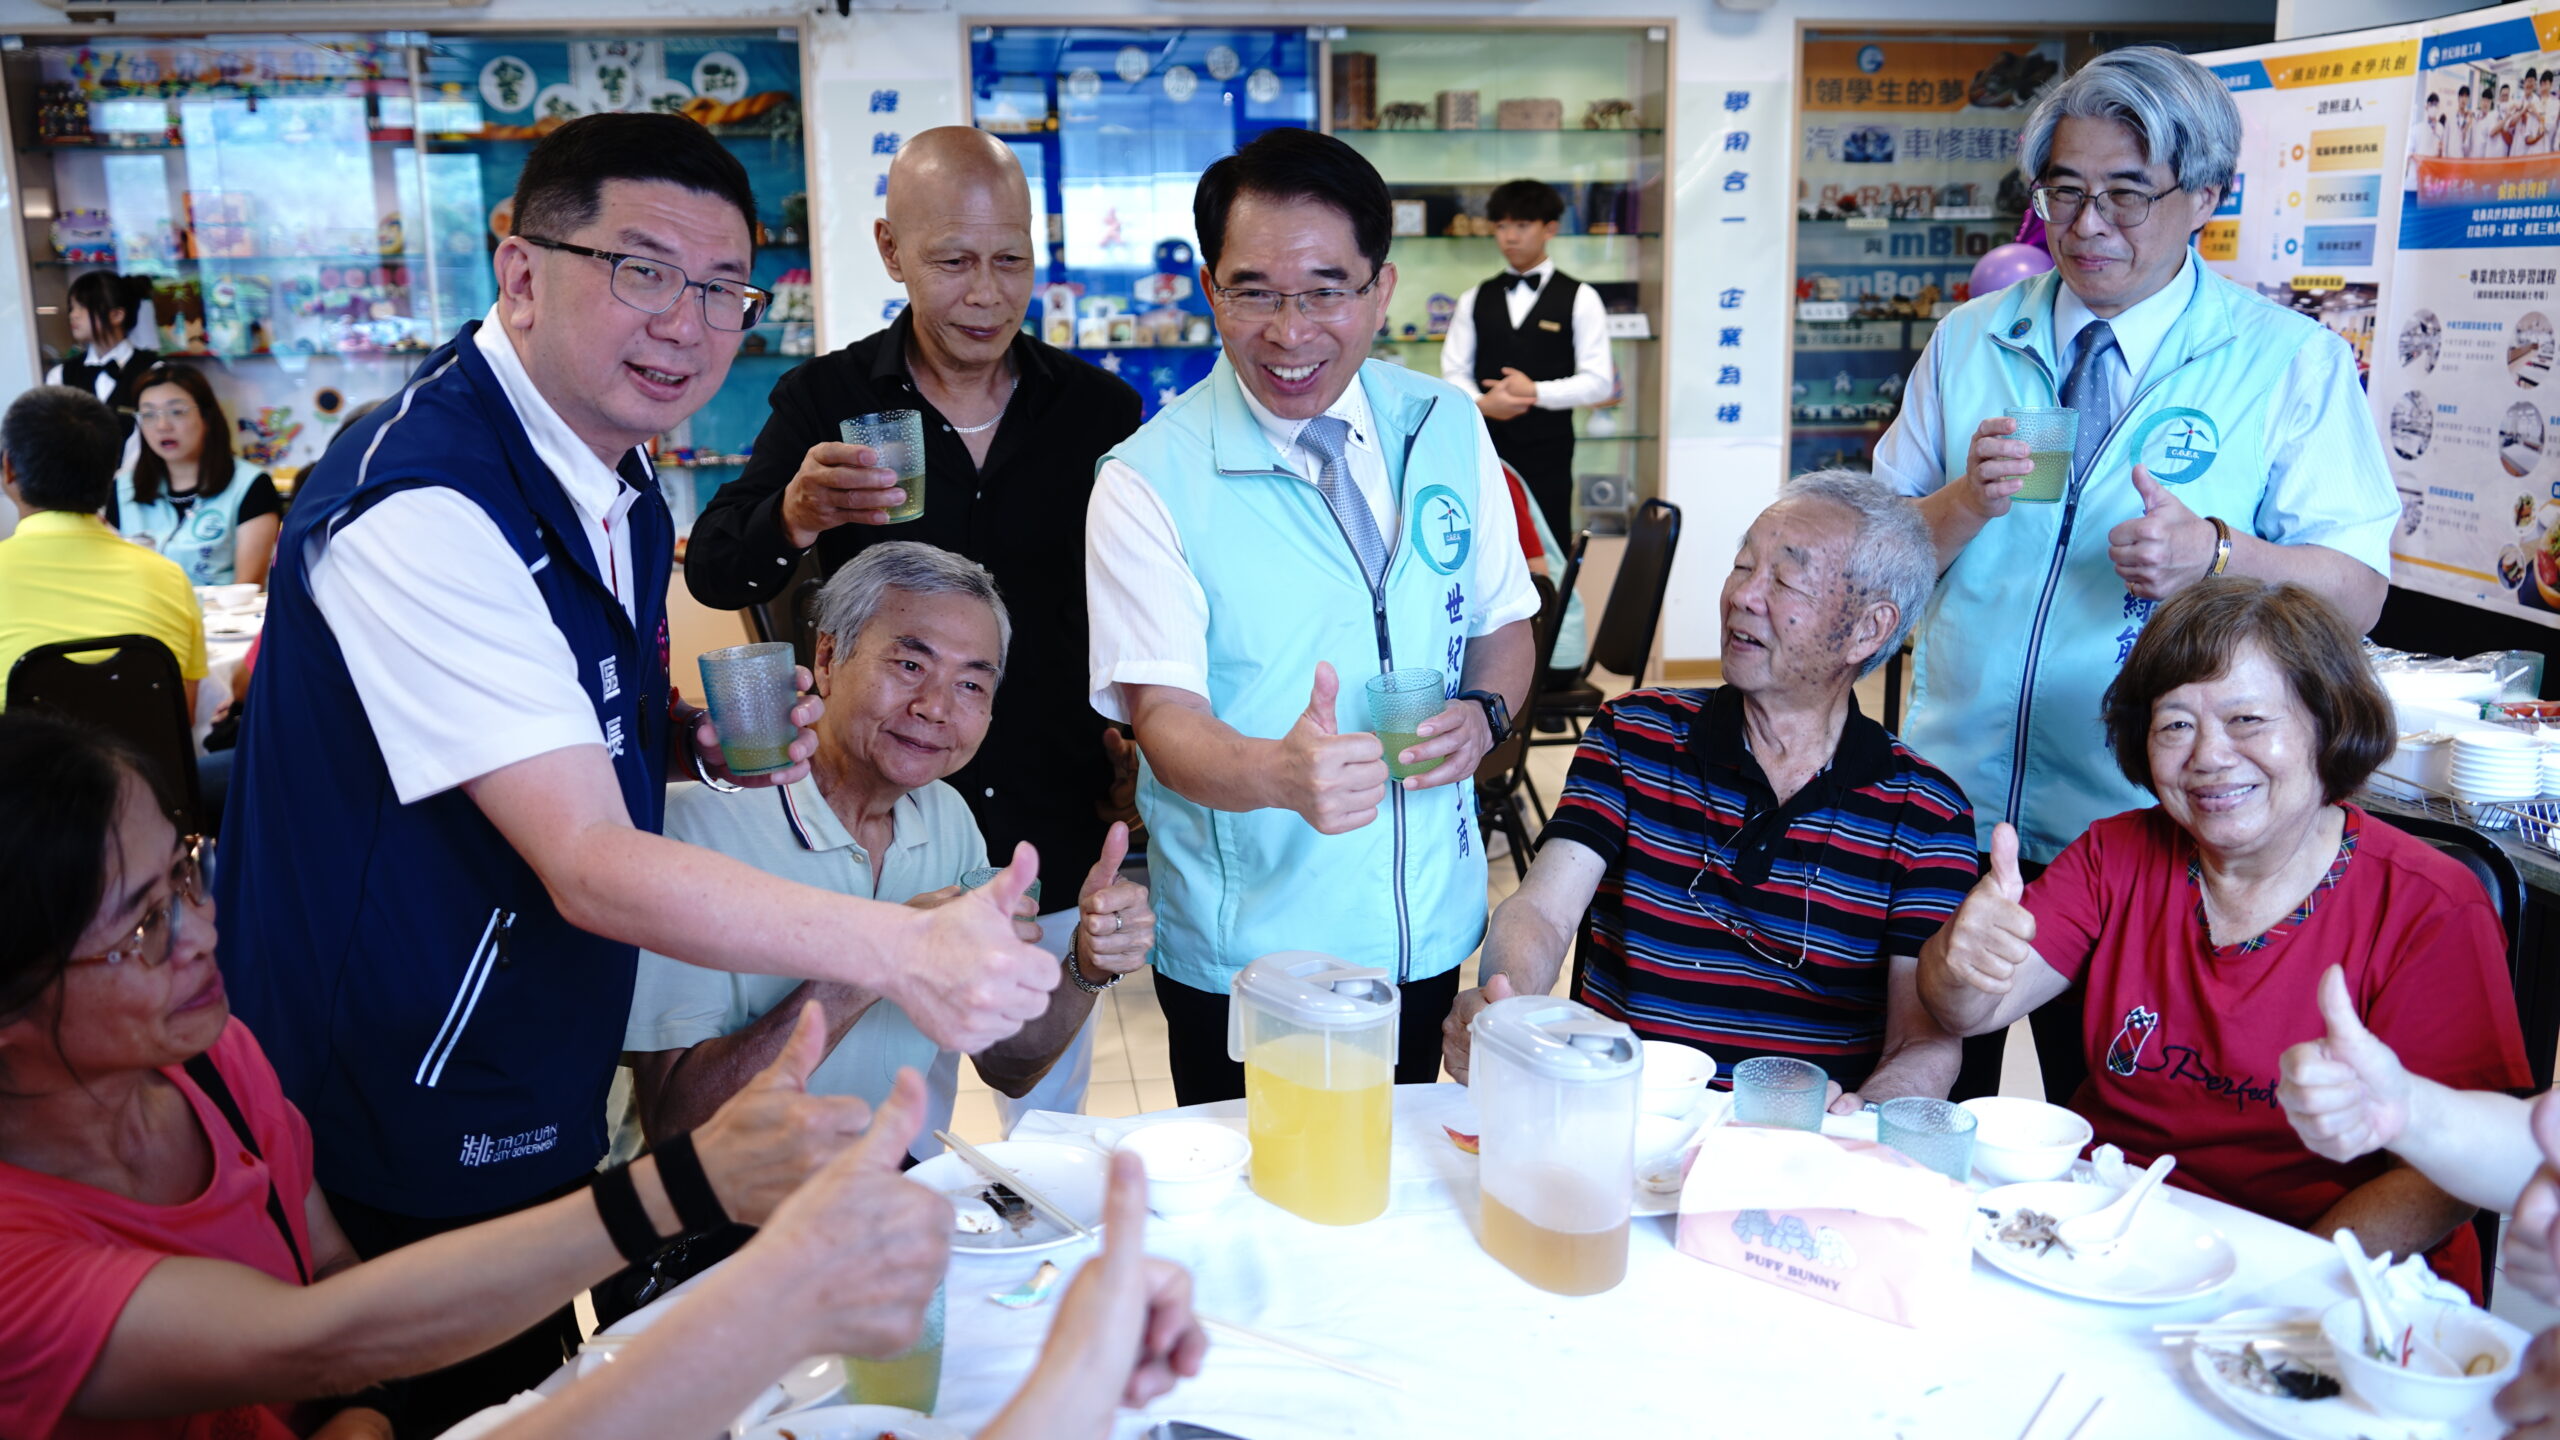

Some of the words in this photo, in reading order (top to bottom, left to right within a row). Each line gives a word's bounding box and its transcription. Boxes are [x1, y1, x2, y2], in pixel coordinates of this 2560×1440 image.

[2351, 55, 2408, 75] 產學共創
[1722, 91, 1751, 223] 學用合一
[2470, 268, 2557, 286] 專業教室及學習課程
[599, 654, 625, 760] 區長
[496, 1122, 559, 1151] TAOYUAN
[511, 1136, 558, 1159] GOVERNMENT
[1745, 1252, 1783, 1272] PUFF
[1787, 1264, 1841, 1292] BUNNY
